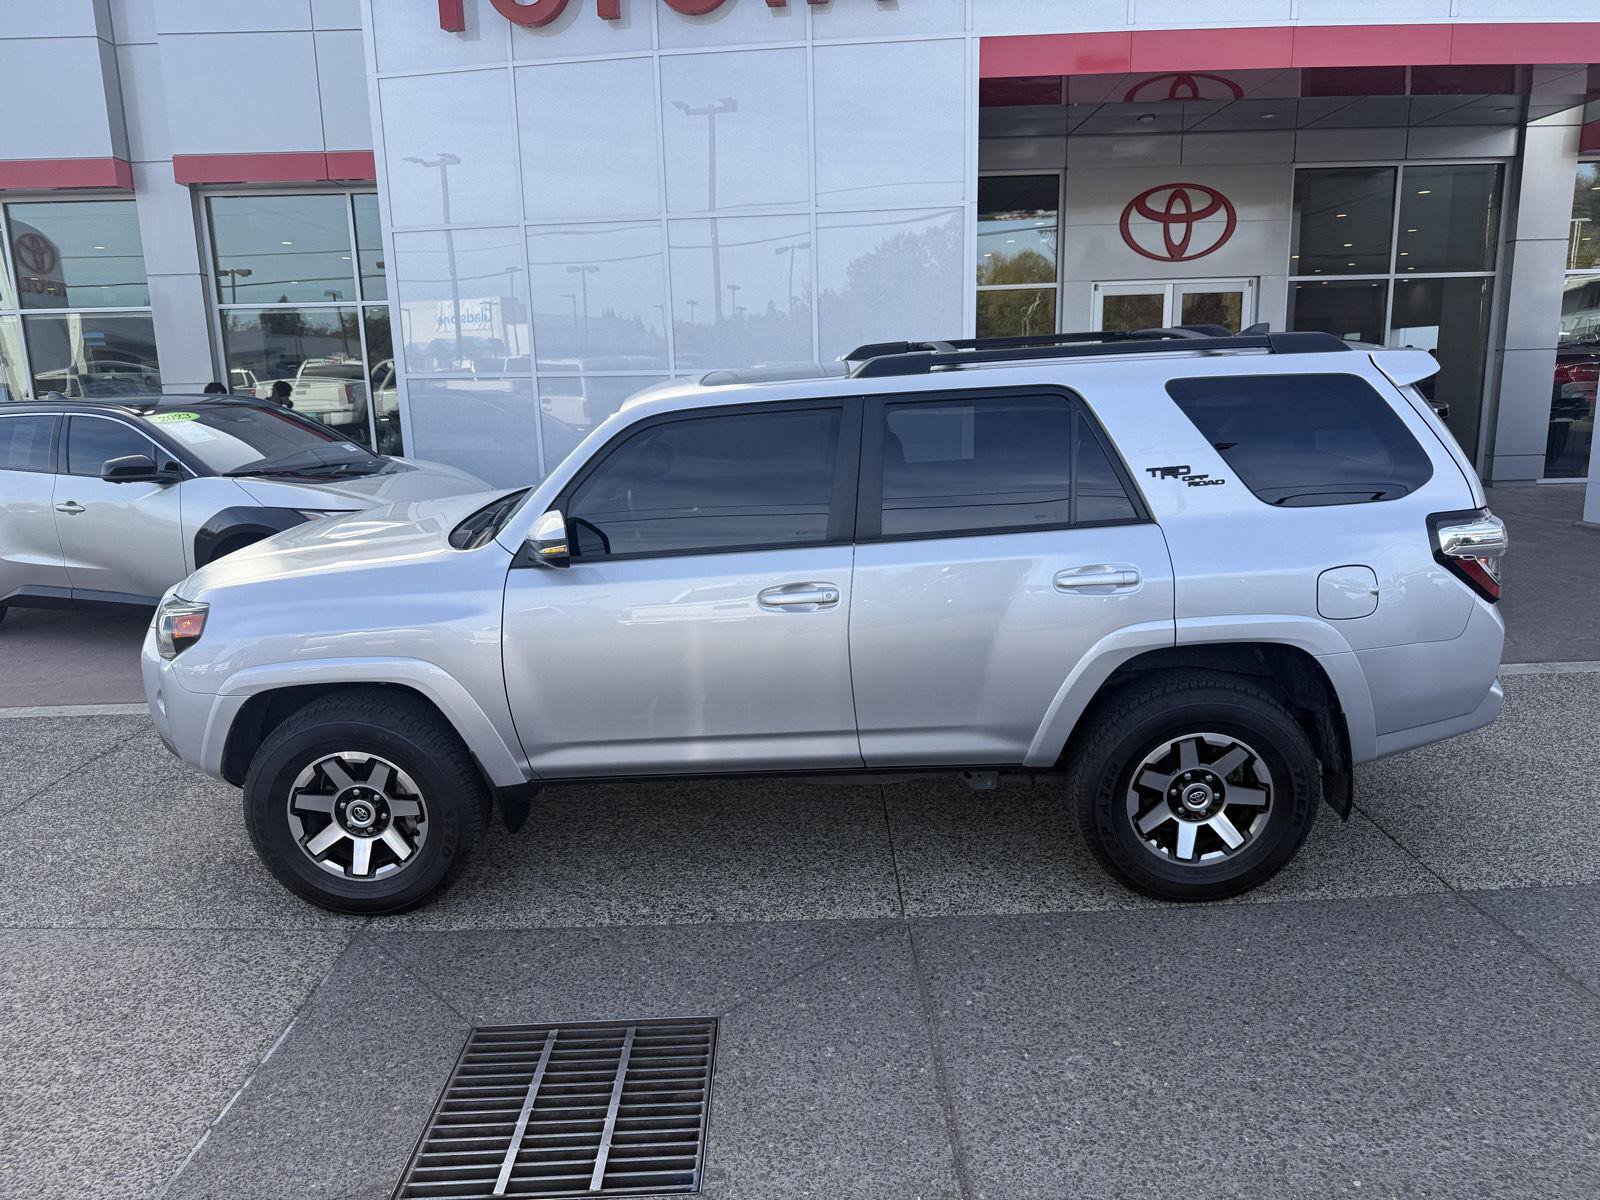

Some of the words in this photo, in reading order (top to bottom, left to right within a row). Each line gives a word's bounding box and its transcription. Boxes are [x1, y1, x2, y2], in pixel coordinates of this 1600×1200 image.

[157, 413, 191, 421] 2023
[1146, 465, 1190, 479] TRD
[1188, 479, 1225, 487] ROAD
